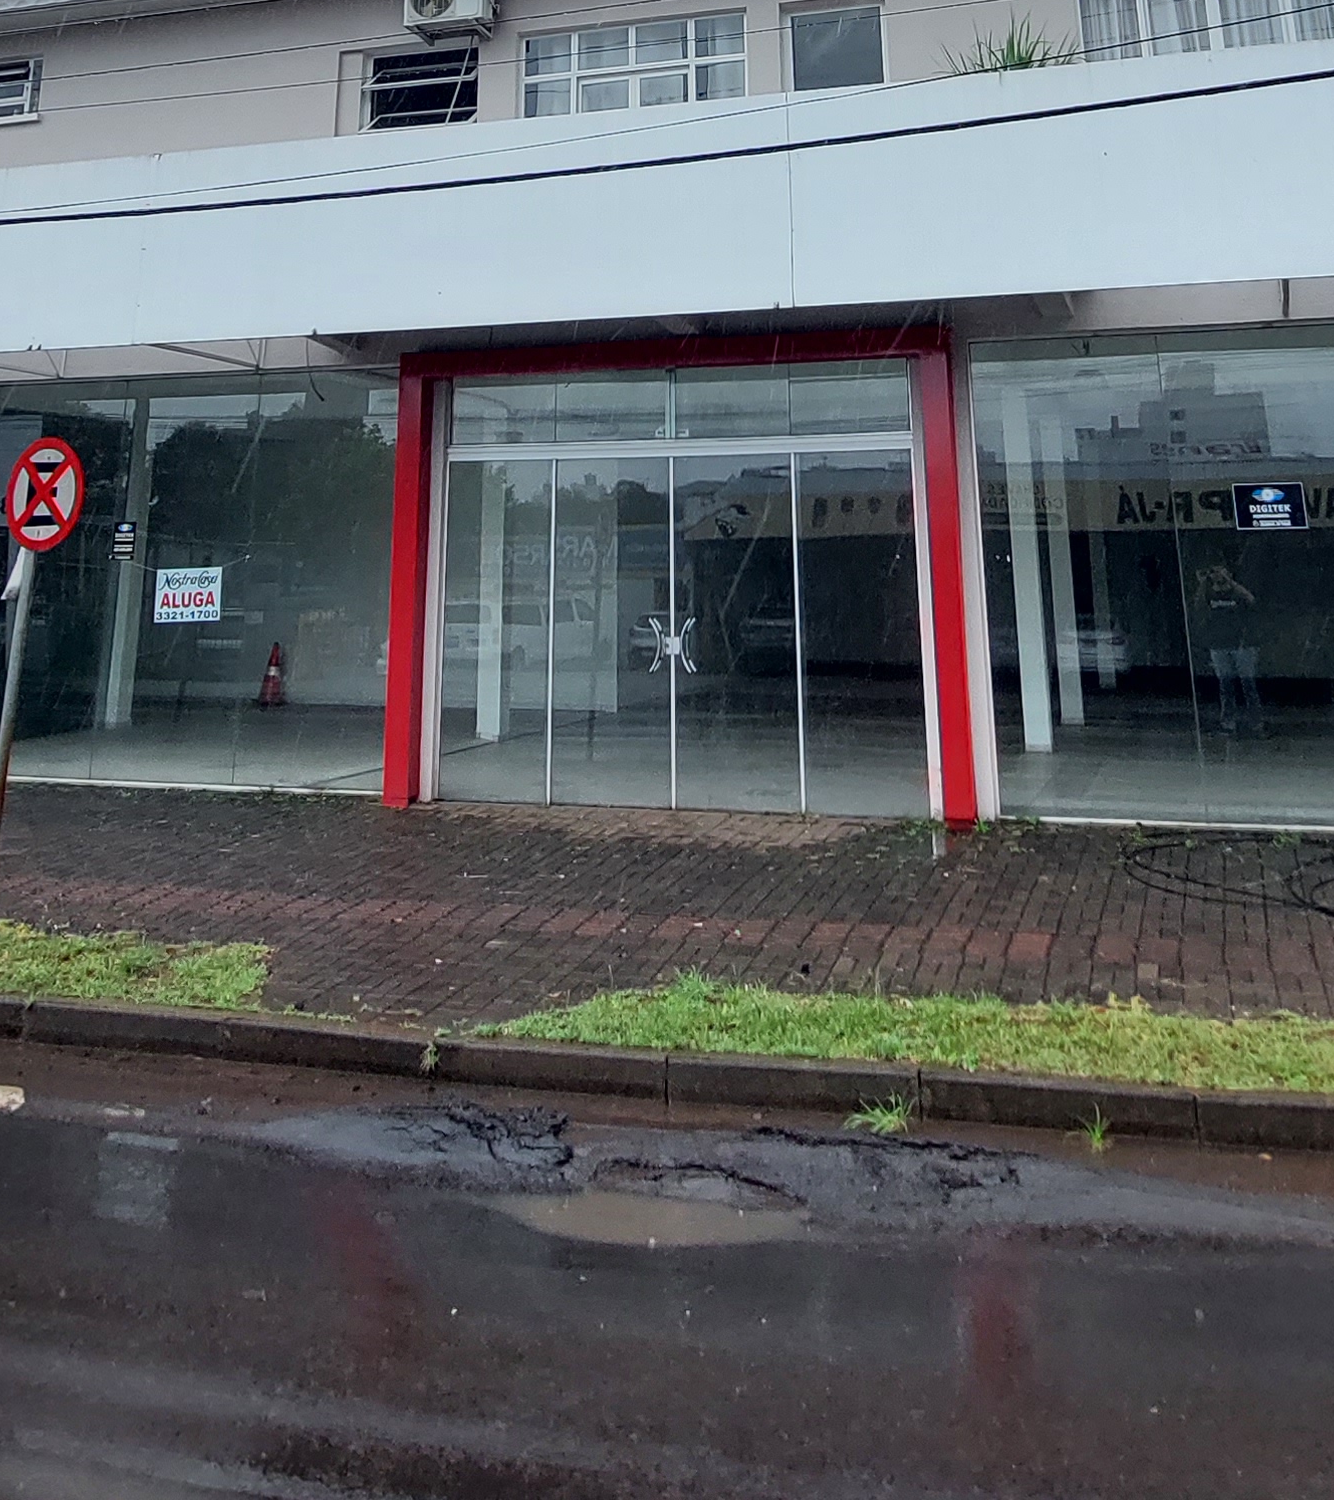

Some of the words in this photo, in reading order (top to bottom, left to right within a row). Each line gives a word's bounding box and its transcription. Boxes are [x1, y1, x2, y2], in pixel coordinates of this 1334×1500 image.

[1249, 503, 1292, 514] DIGITEK
[159, 591, 216, 610] ALUGA
[155, 609, 219, 621] 3321-1700
